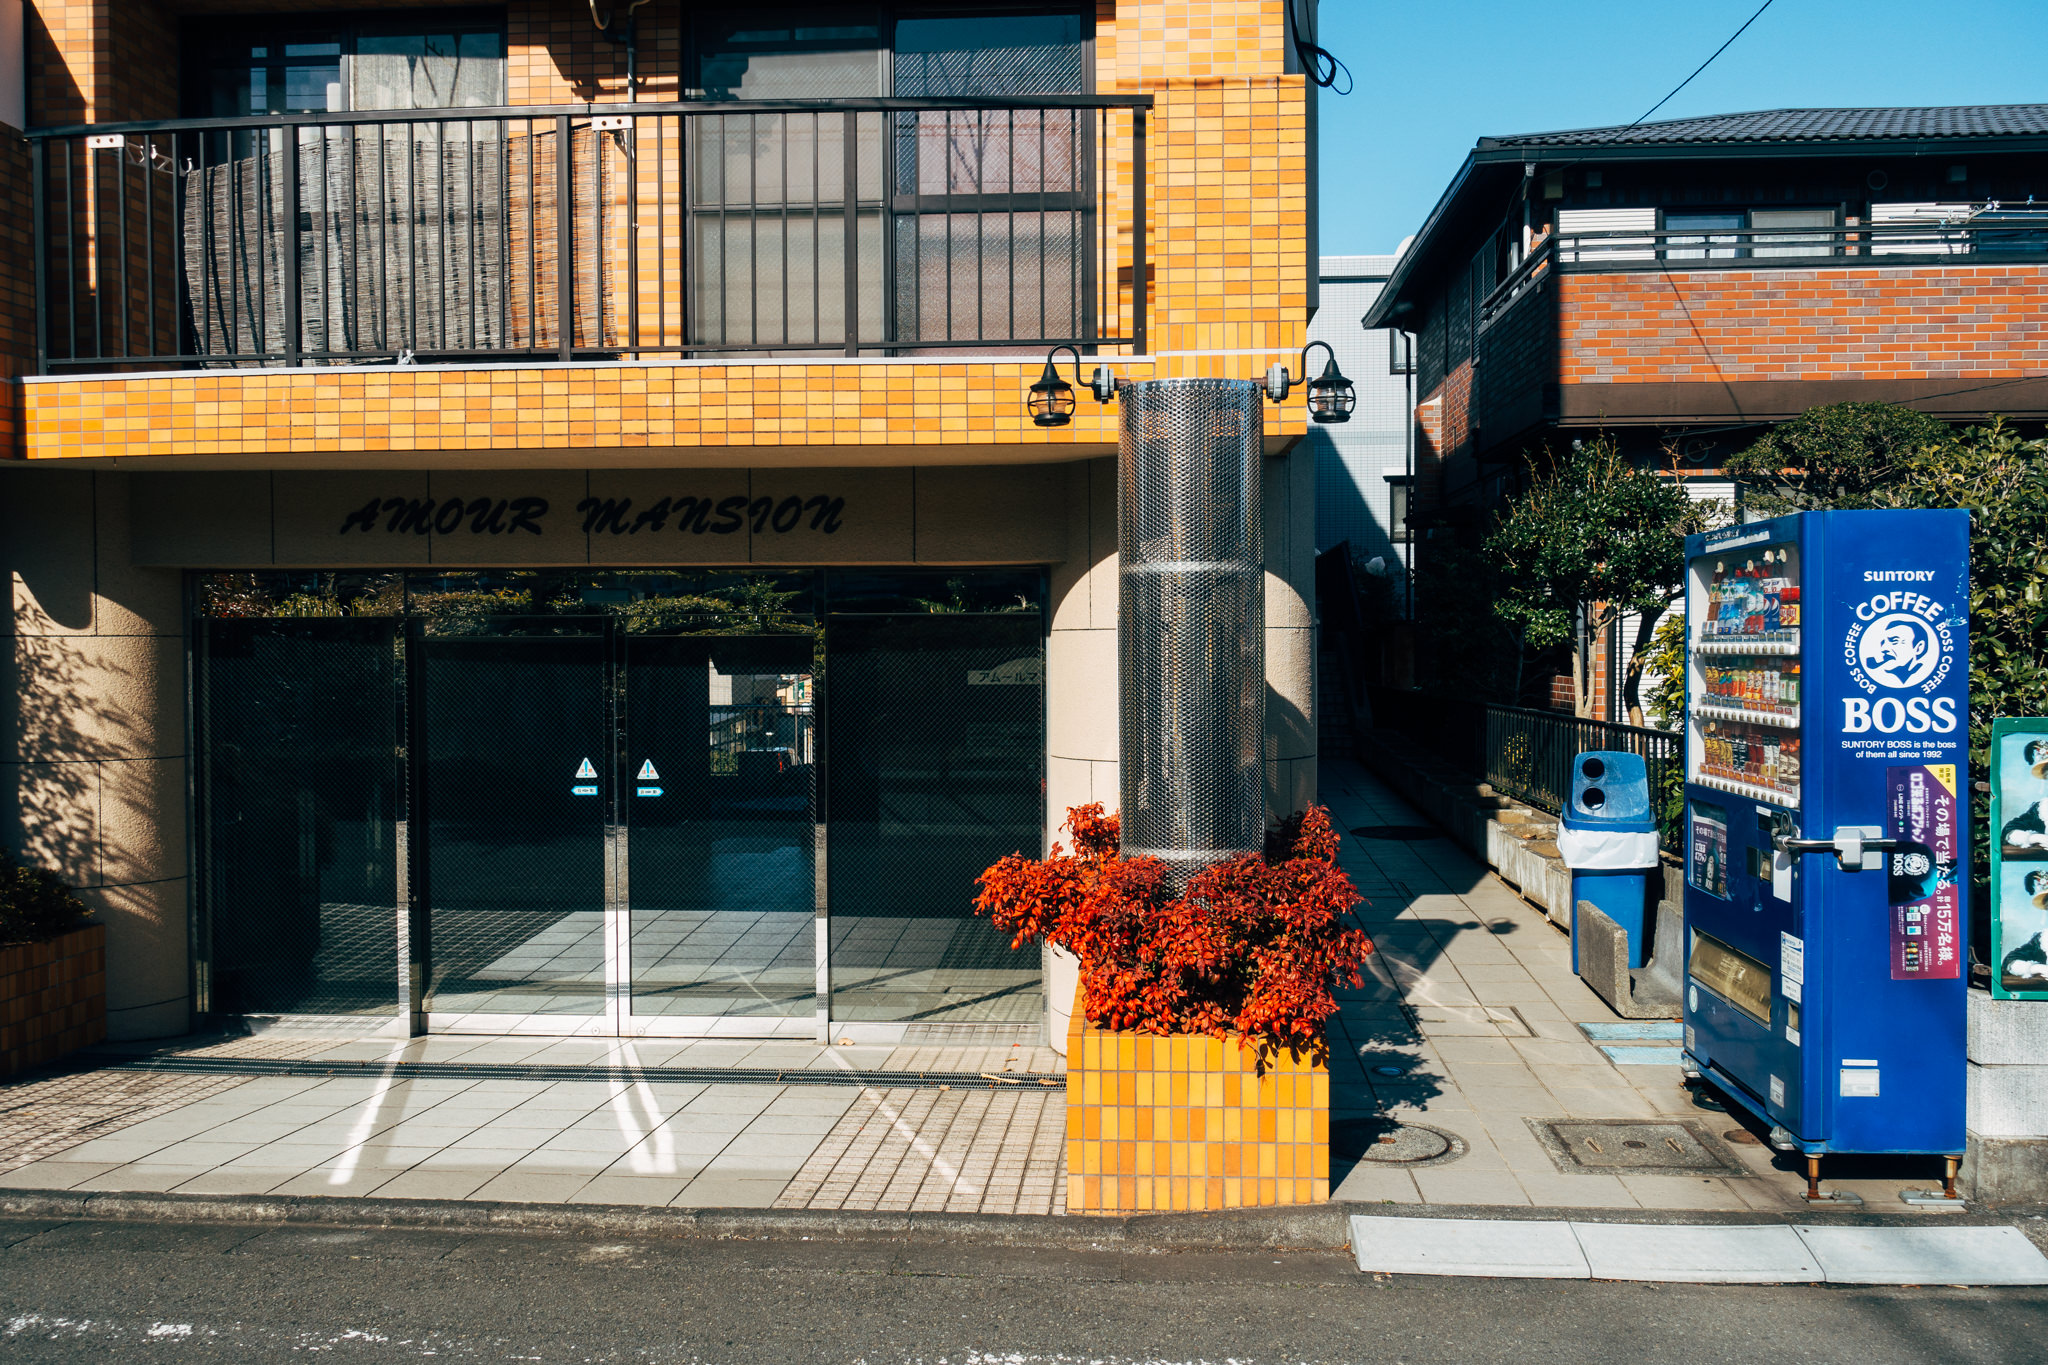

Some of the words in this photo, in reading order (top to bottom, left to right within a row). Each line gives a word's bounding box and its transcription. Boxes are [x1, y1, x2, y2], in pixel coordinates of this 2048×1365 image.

[339, 497, 549, 535] AMOUR
[576, 495, 845, 535] MANSION
[1856, 591, 1944, 622] COFFEE
[1844, 622, 1863, 666] COFFEE
[1935, 621, 1954, 652] BOSS
[1849, 667, 1878, 694] BOSS
[1920, 655, 1953, 694] COFFEE
[1841, 697, 1957, 733] BOSS
[1841, 740, 1885, 749] SUNTORY
[1887, 740, 1912, 749] BOSS
[1914, 740, 1921, 749] is
[1922, 740, 1936, 749] the
[1937, 740, 1957, 749] boss
[1855, 751, 1864, 759] of
[1865, 751, 1886, 759] them
[1888, 751, 1897, 759] all
[1898, 751, 1920, 759] since
[1922, 751, 1942, 759] 1992
[1892, 853, 1904, 876] BOSS
